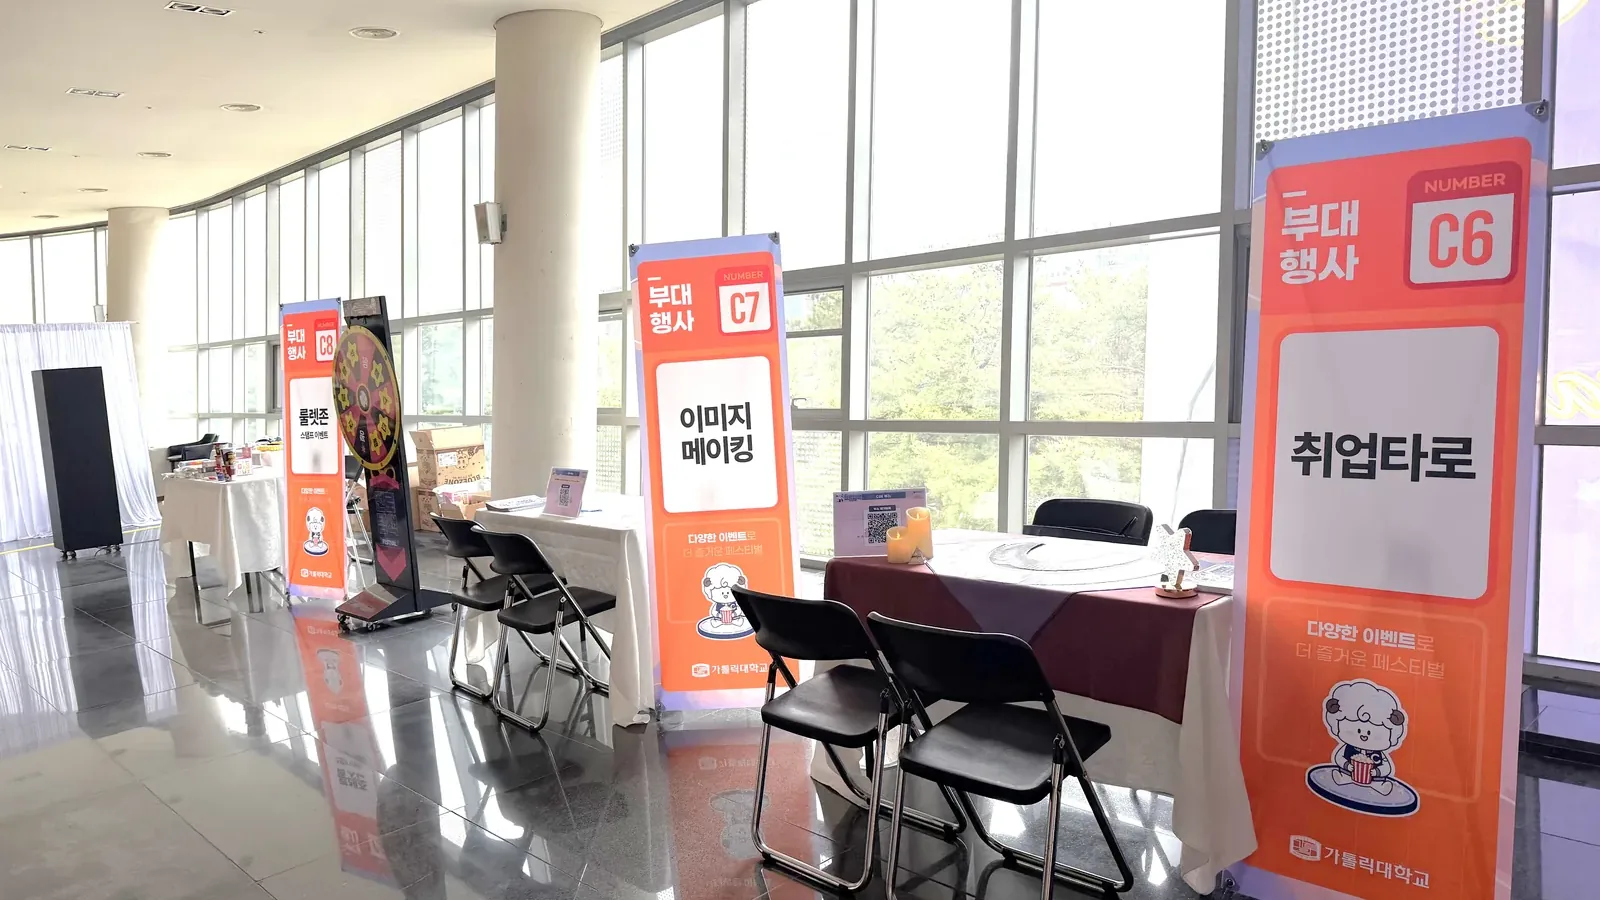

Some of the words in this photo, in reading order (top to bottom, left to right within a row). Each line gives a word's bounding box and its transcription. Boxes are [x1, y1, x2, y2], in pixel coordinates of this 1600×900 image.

[1424, 172, 1507, 194] NUMBER
[1282, 200, 1360, 242] 부대
[1428, 209, 1494, 269] C6
[723, 271, 764, 281] NUMBER
[1280, 244, 1360, 285] 행사
[649, 283, 693, 308] 부대
[730, 291, 760, 324] C7
[649, 310, 695, 334] 행사
[287, 328, 305, 344] 부대
[320, 335, 334, 355] C8
[287, 345, 306, 360] 행사
[299, 408, 329, 426] 룰렛존
[680, 401, 752, 433] 이미지
[300, 431, 314, 440] 스탬프
[314, 430, 329, 440] 이벤트
[681, 434, 753, 466] 메이킹
[1291, 431, 1476, 482] 취업타로
[687, 532, 717, 544] 다양한
[718, 530, 757, 542] 이벤트로
[1307, 619, 1359, 643] 다양한
[1362, 627, 1436, 653] 이벤트로
[711, 662, 769, 675] 가톨릭대학교
[1295, 642, 1312, 659] 더
[1316, 644, 1369, 668] 즐거운
[1372, 652, 1446, 680] 페스티벌
[1324, 846, 1430, 889] 가톨릭대학교
